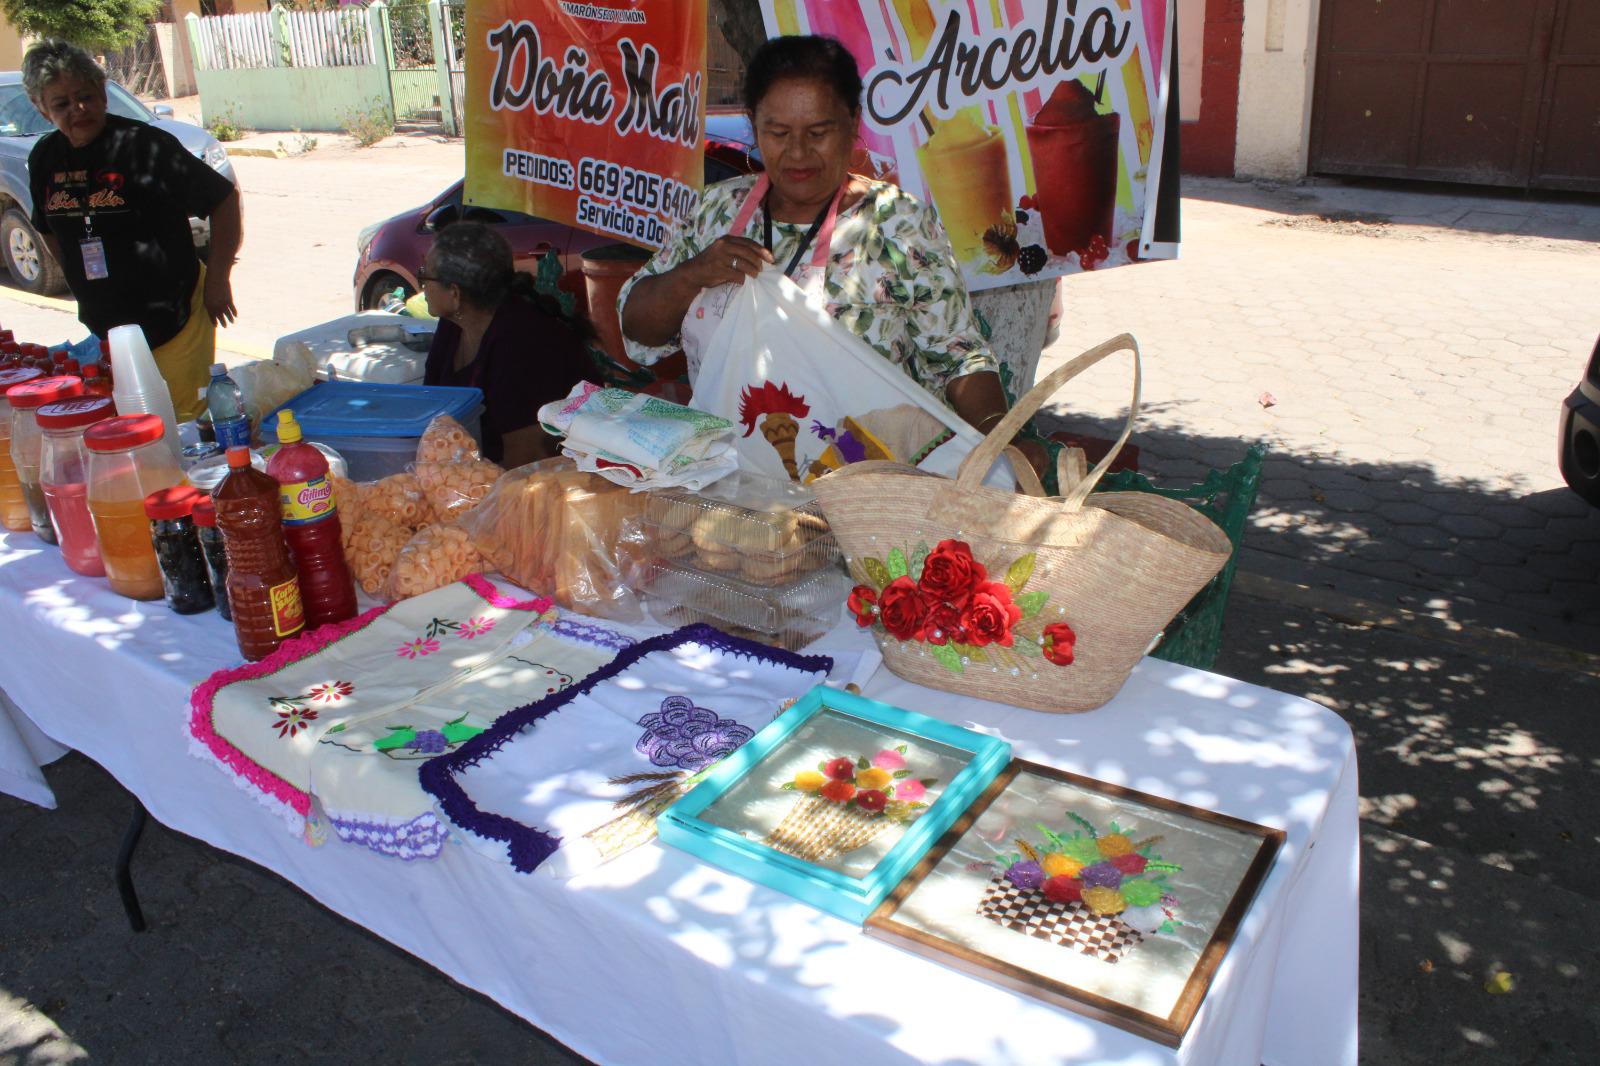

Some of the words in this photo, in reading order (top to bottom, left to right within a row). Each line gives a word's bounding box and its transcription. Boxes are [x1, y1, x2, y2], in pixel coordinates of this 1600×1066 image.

[489, 22, 614, 122] Doña
[617, 40, 701, 147] Mari
[866, 0, 1131, 126] Arcelia
[506, 152, 574, 187] PEDIDOS:
[580, 160, 620, 198] 669
[622, 170, 660, 209] 205
[578, 198, 635, 234] Servicio
[636, 218, 645, 239] a
